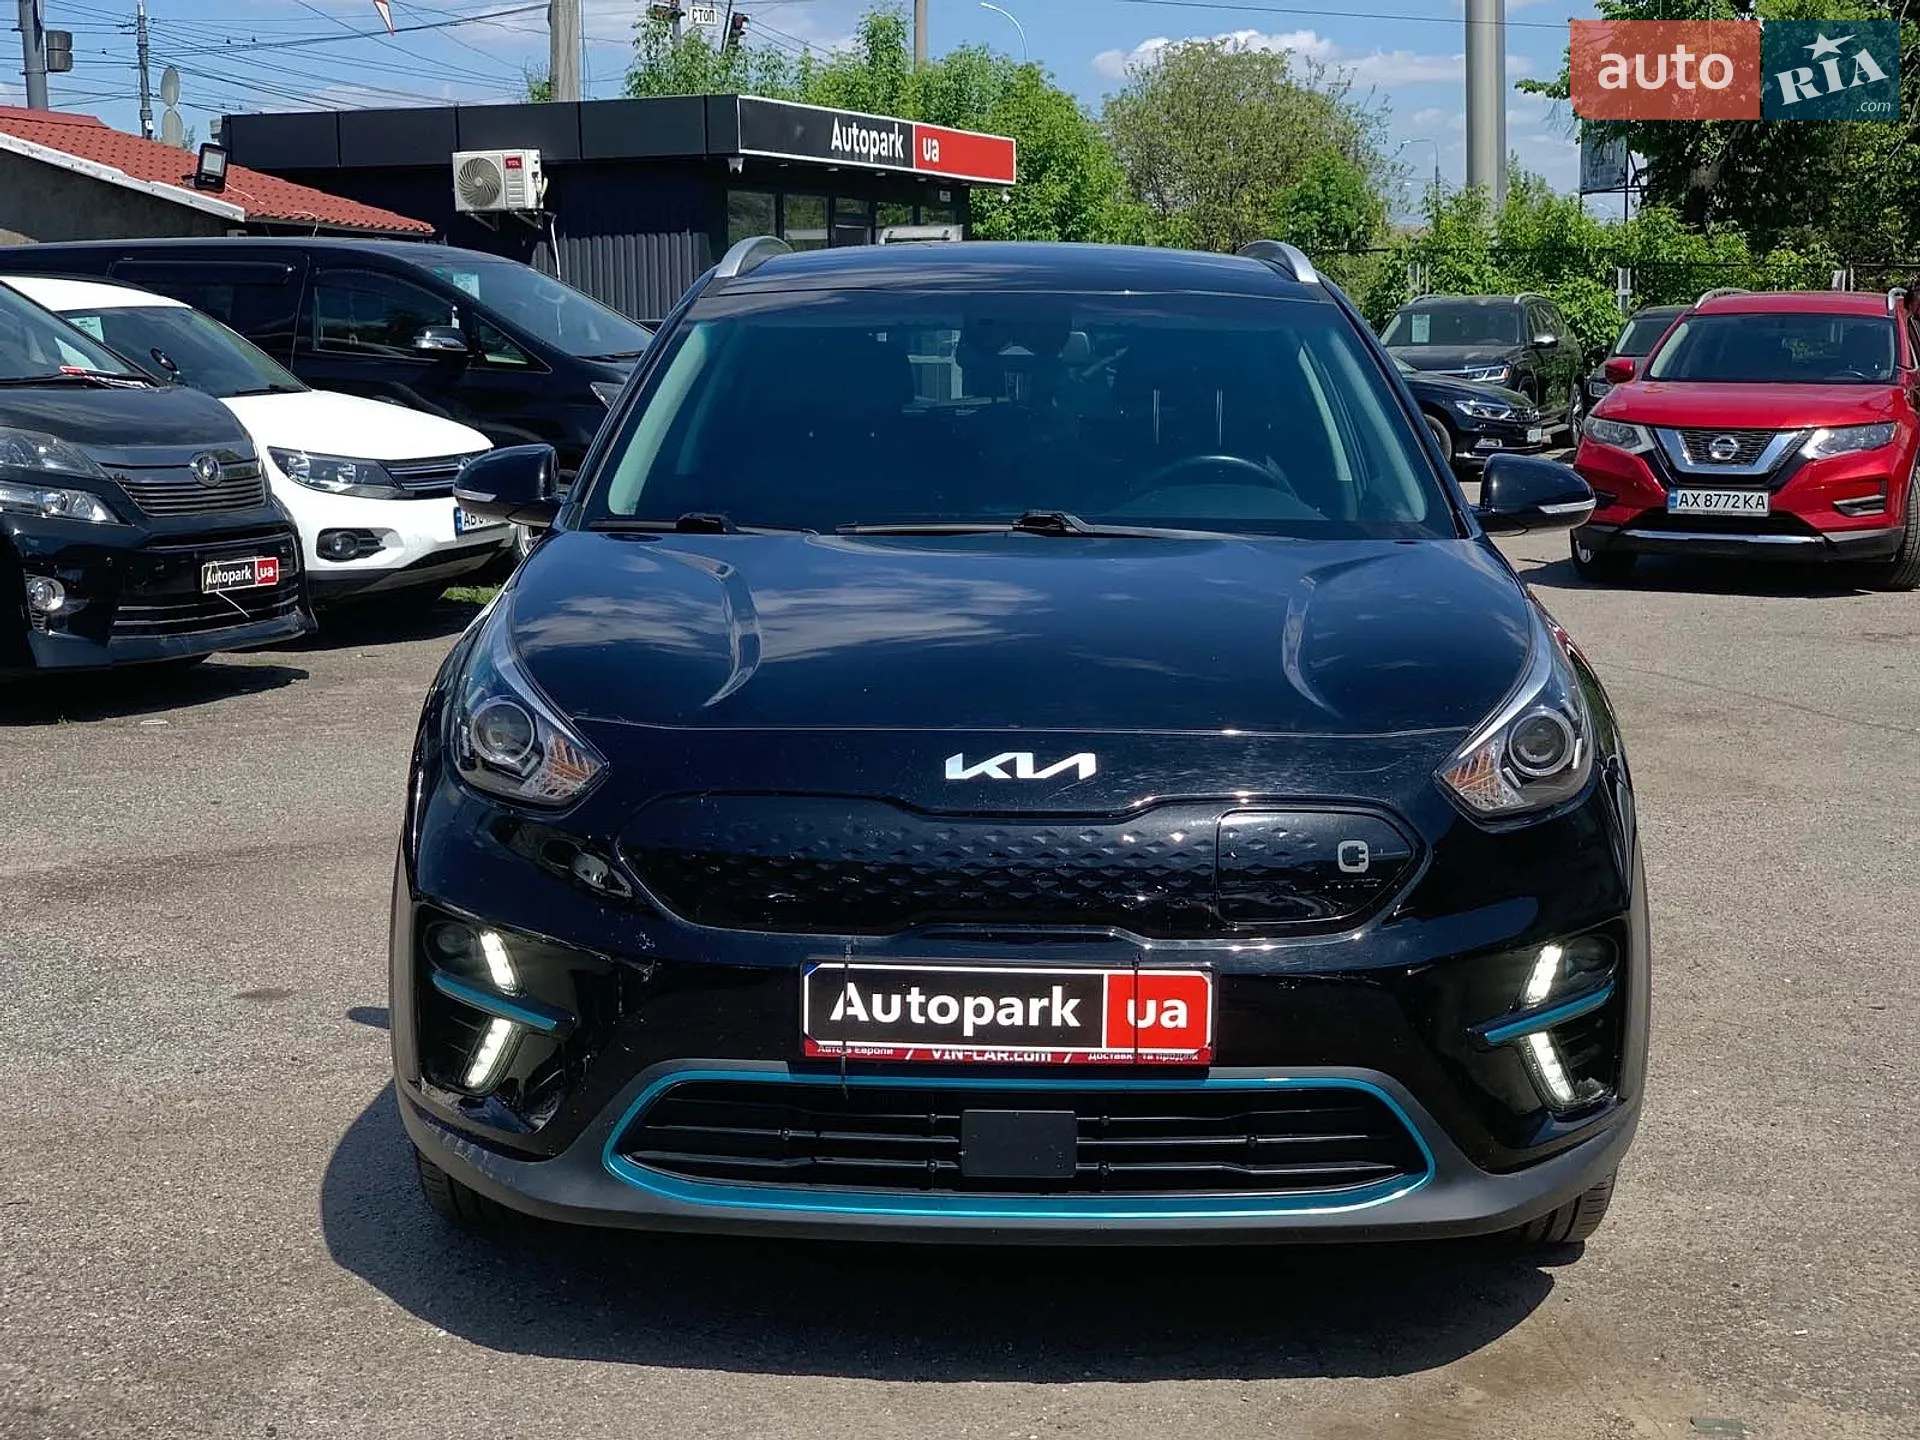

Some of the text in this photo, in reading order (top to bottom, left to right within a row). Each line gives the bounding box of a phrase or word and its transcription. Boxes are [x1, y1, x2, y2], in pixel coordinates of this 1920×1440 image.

[692, 9, 715, 22] СТОП
[831, 117, 940, 162] Autopark ua
[1679, 493, 1766, 509] AX 8772 KA
[206, 565, 274, 585] Autopark ua
[945, 752, 1097, 780] KIA
[830, 982, 1188, 1037] Autopark ua
